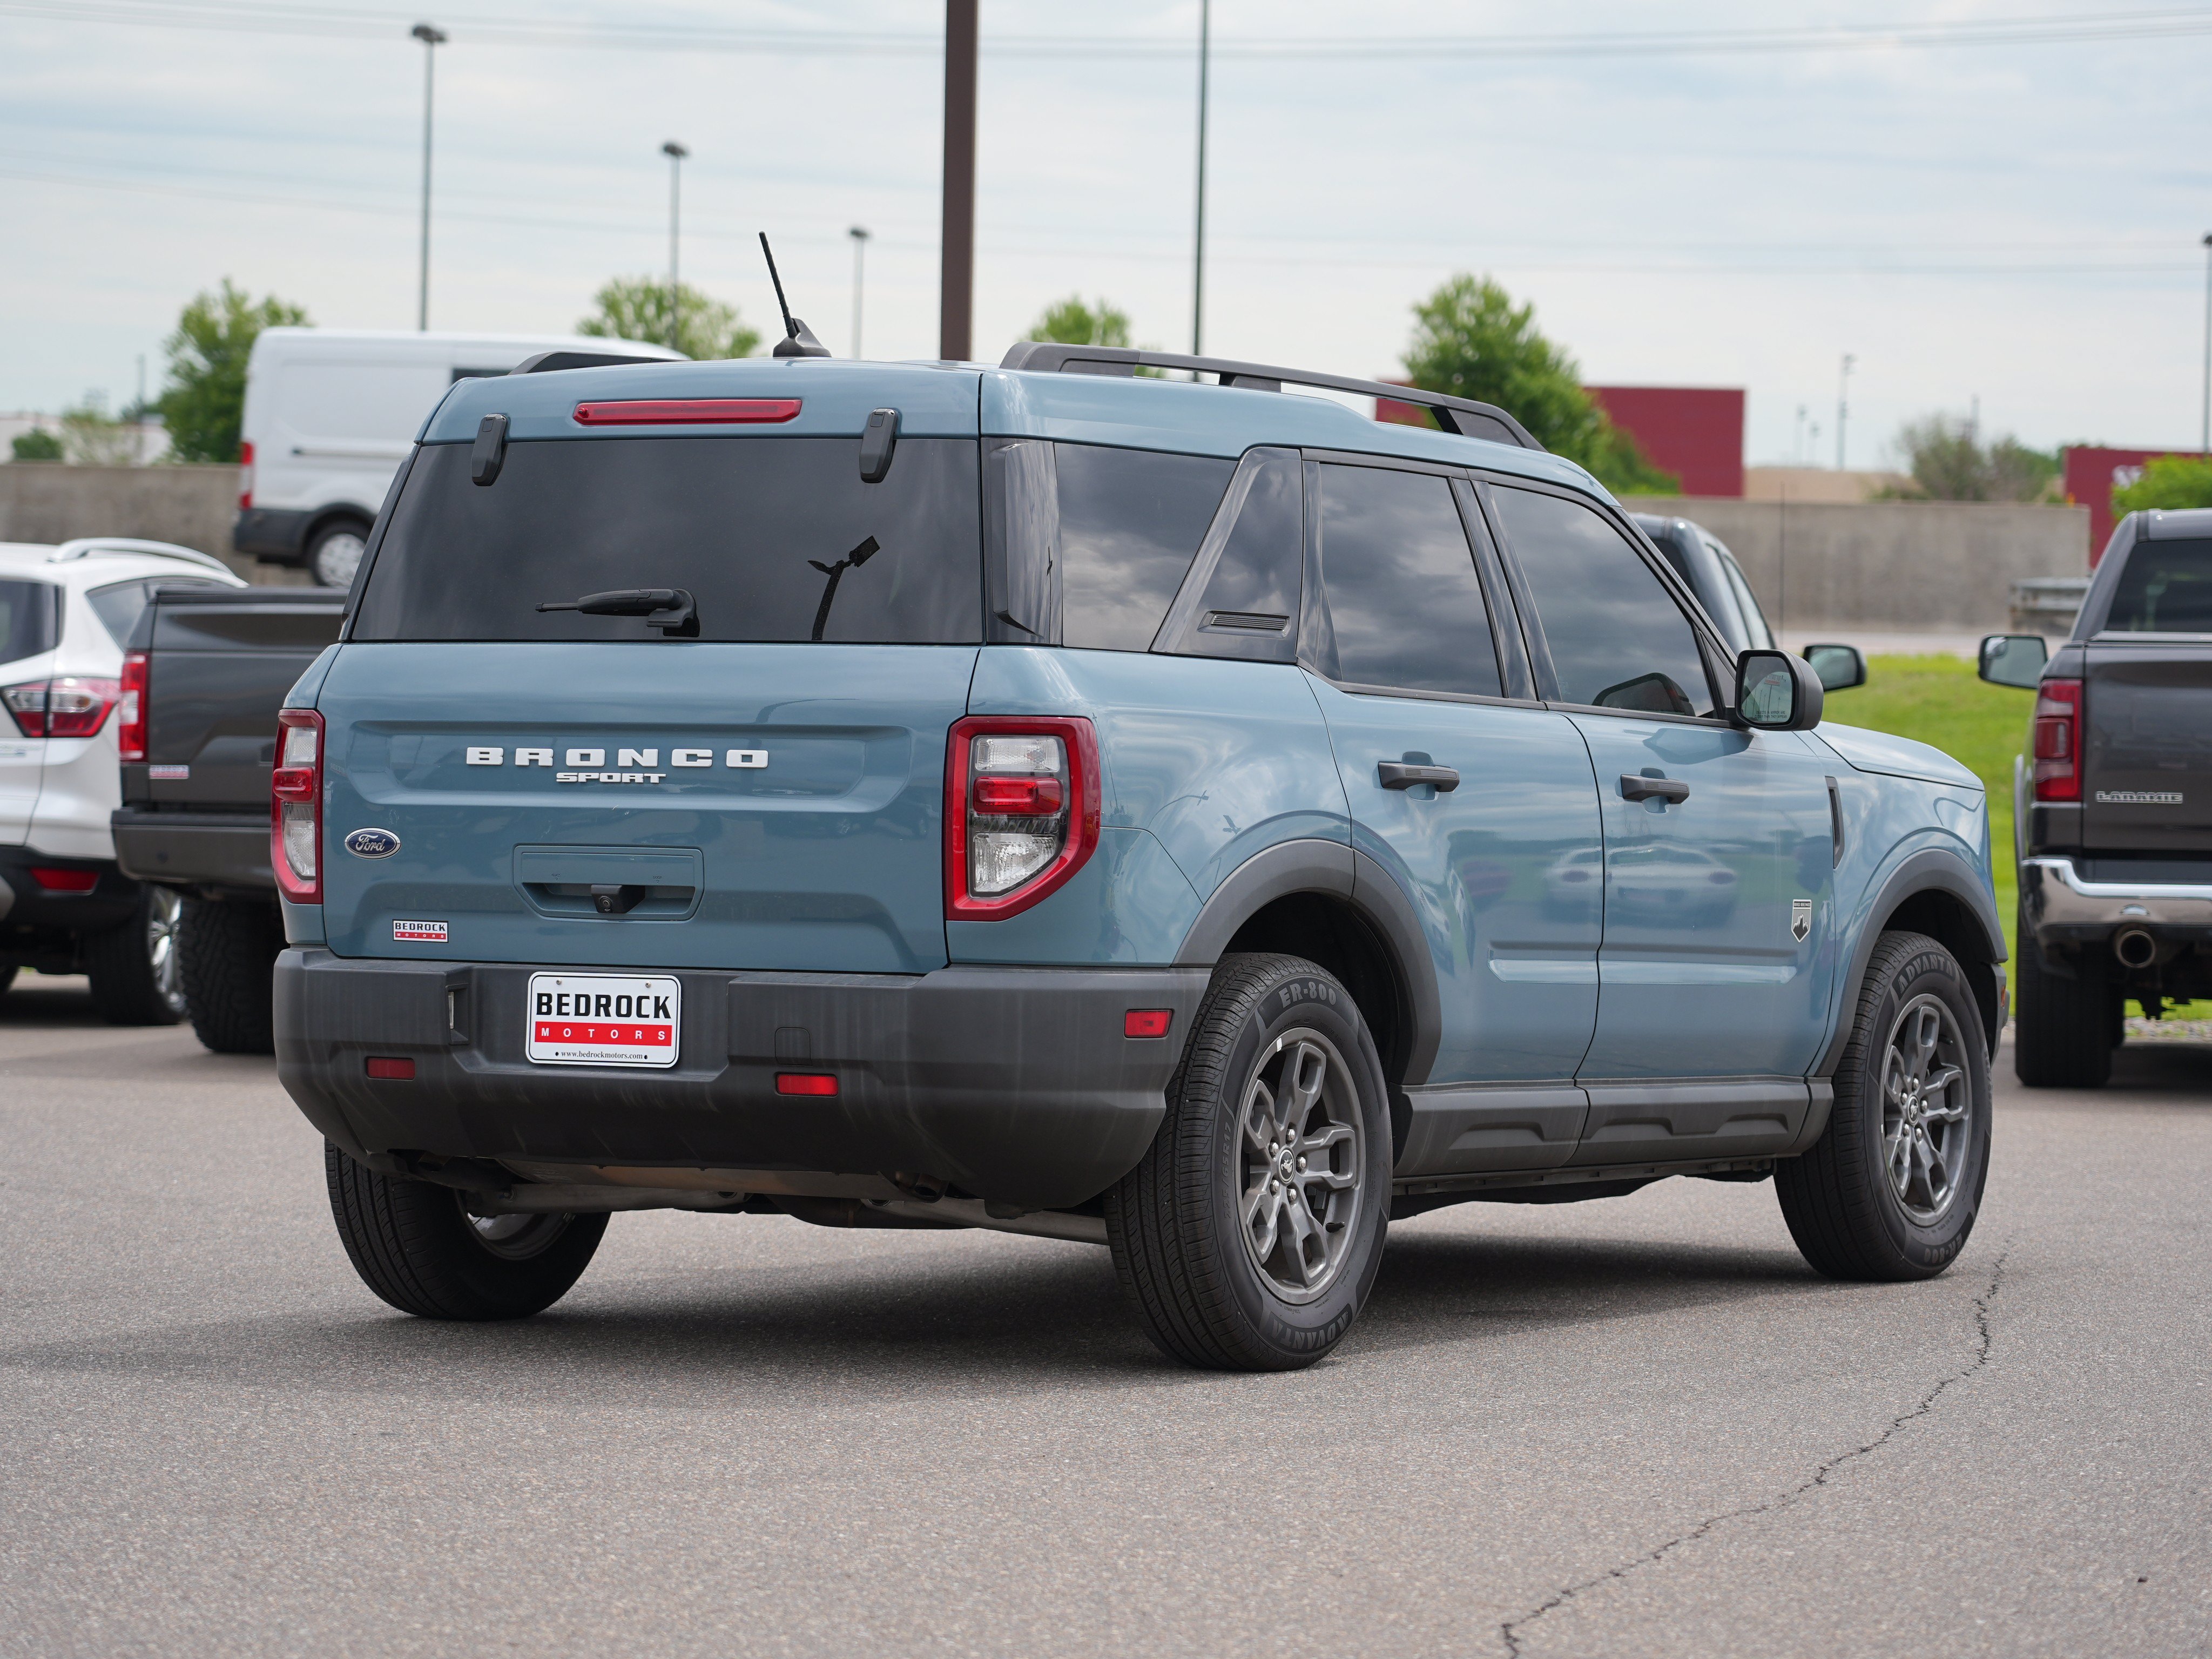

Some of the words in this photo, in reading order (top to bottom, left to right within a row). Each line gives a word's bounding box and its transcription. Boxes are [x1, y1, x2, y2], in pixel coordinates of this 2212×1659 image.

[467, 747, 768, 768] BRONCO
[556, 772, 666, 783] SPORT
[355, 834, 386, 851] Ford
[395, 922, 446, 932] BEDROCK
[1898, 954, 1953, 994] ADVANTA
[1278, 981, 1337, 1008] ER-800
[536, 993, 671, 1019] BEDROCK
[541, 1027, 665, 1041] MOTORS
[561, 1050, 643, 1060] www.bedrockmotors.com
[1222, 1122, 1232, 1219] 225/65R17
[1270, 1311, 1348, 1350] ADVANTA
